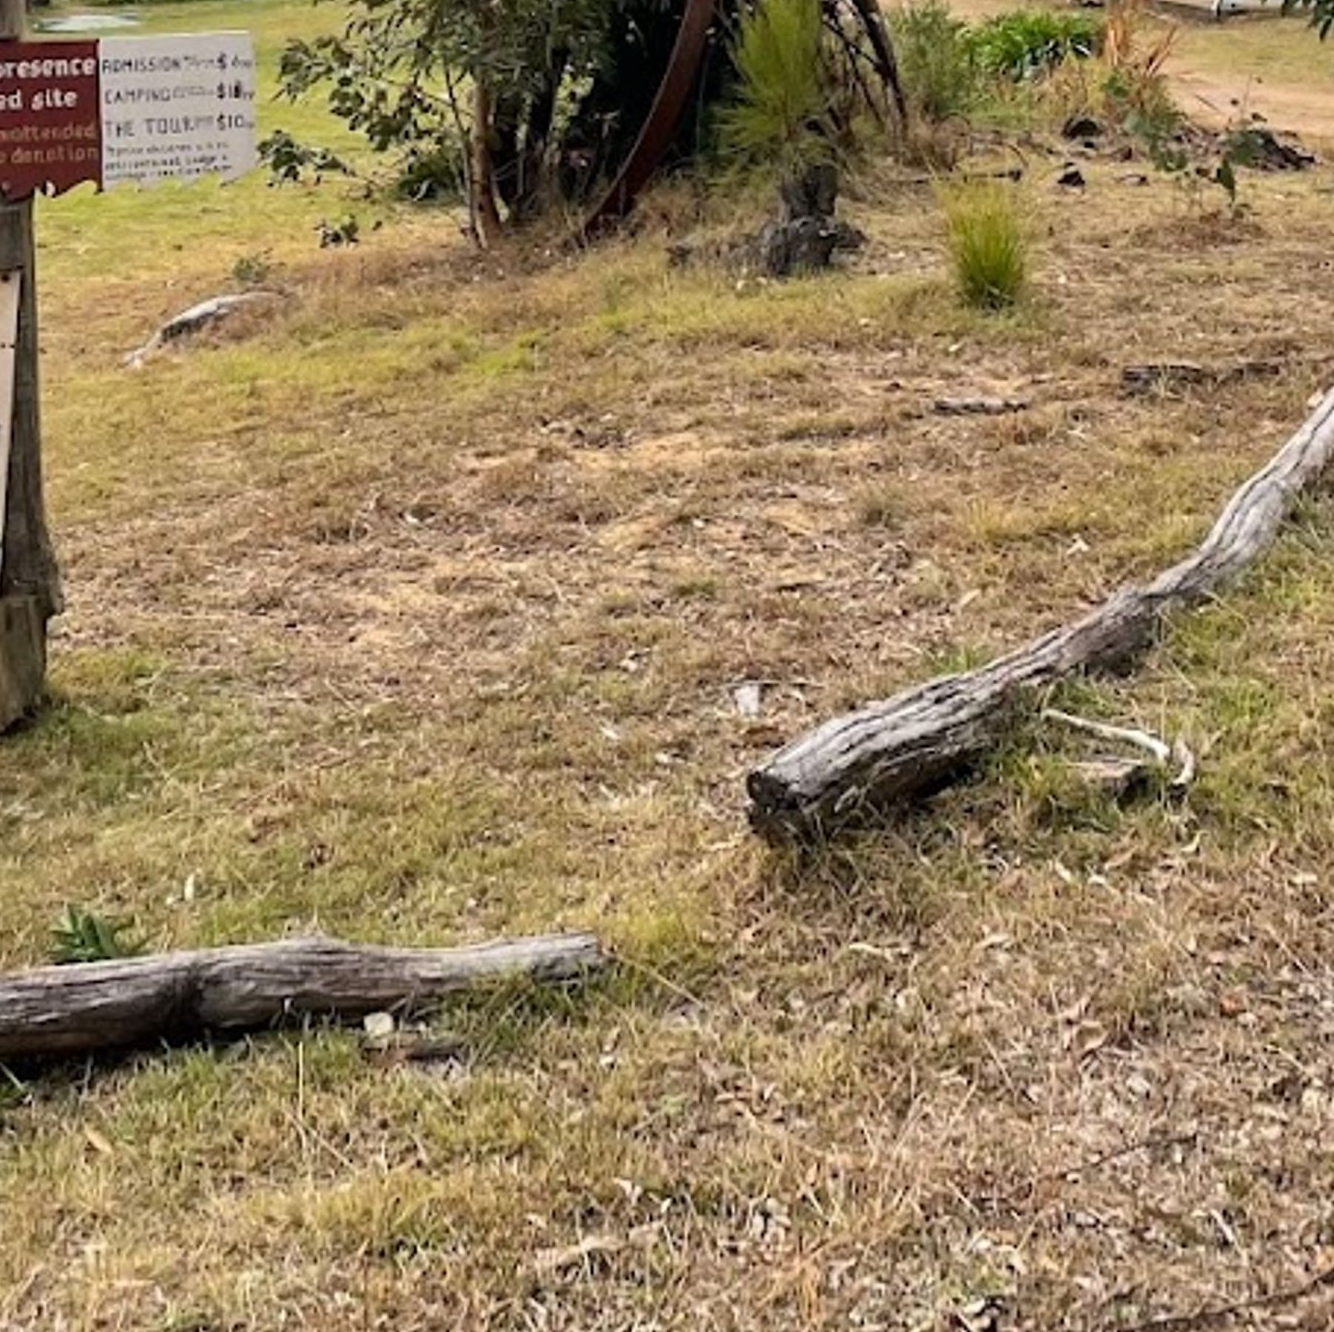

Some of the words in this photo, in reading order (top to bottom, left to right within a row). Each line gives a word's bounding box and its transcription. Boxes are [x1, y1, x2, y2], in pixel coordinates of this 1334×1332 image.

[102, 59, 180, 74] ADMISSION
[31, 88, 78, 110] site
[105, 88, 171, 105] CAMPING
[105, 120, 135, 137] THE
[11, 147, 98, 164] donation
